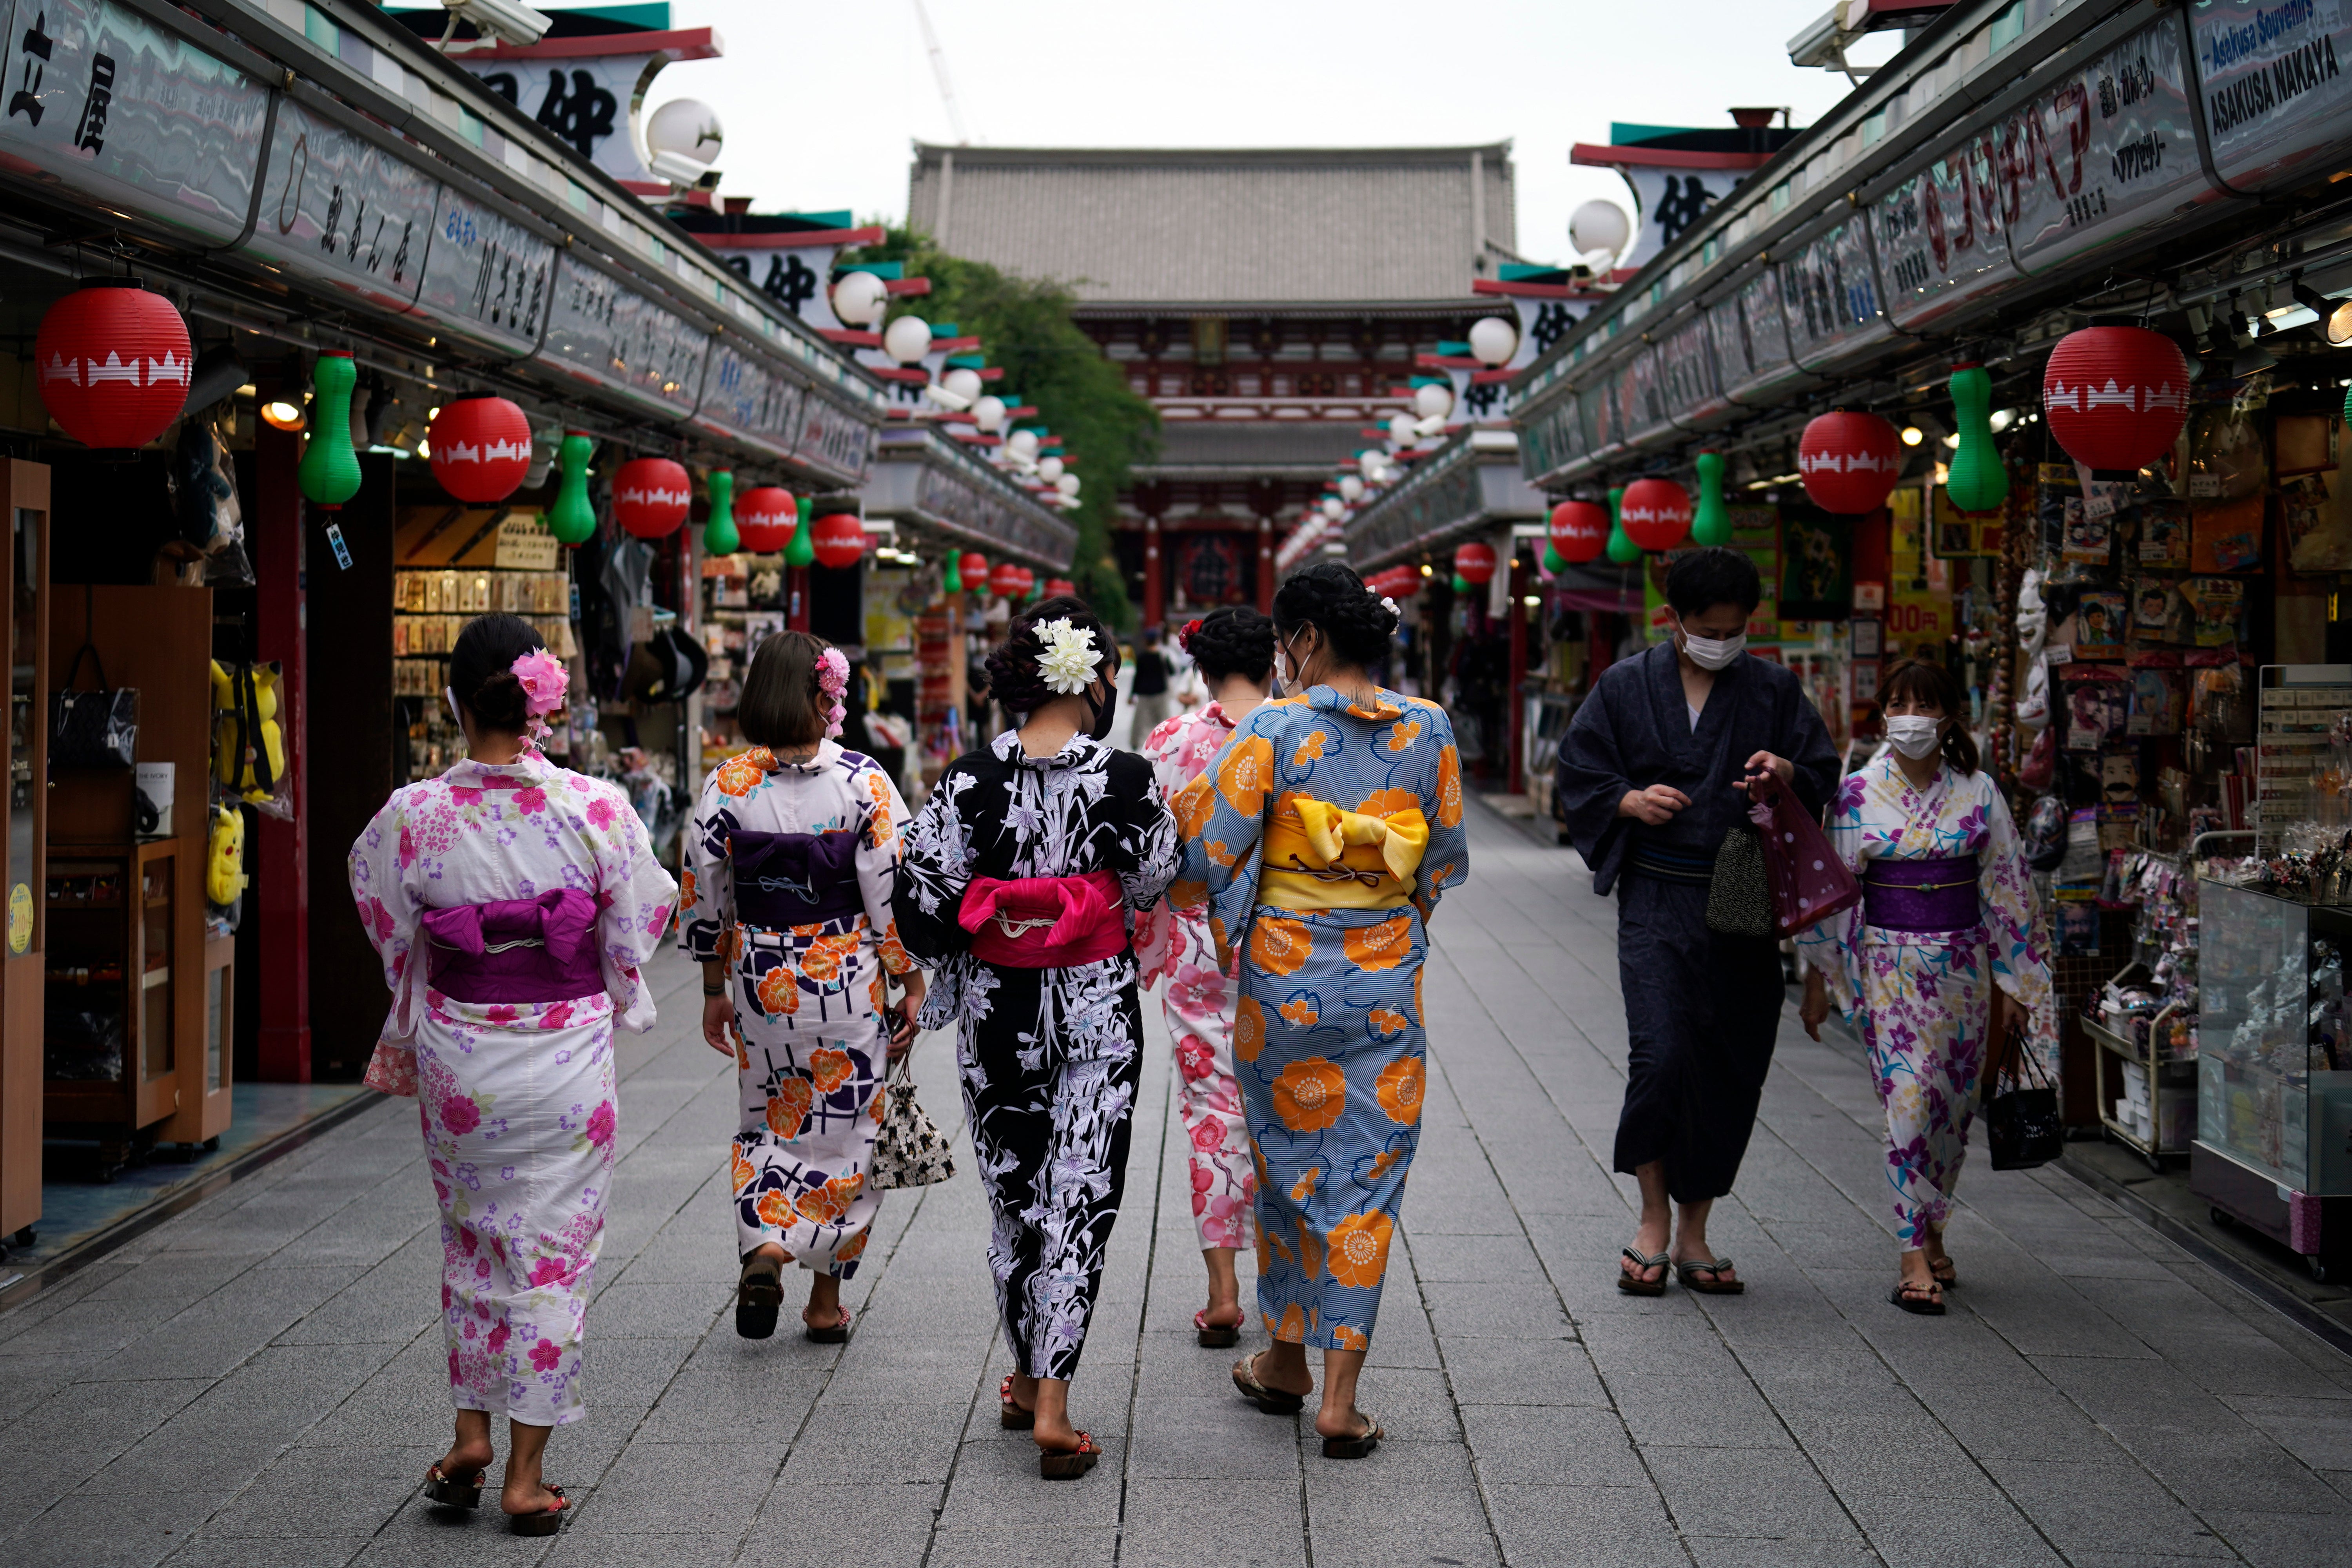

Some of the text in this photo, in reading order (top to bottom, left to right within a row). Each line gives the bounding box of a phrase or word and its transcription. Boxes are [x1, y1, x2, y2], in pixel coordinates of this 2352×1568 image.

[2212, 23, 2257, 72] Asakusa
[2257, 0, 2313, 45] Souvenirs
[9, 10, 116, 156] 立屋
[2210, 33, 2339, 136] ASAKUSA NAKAYA
[330, 529, 350, 567] 仲見世
